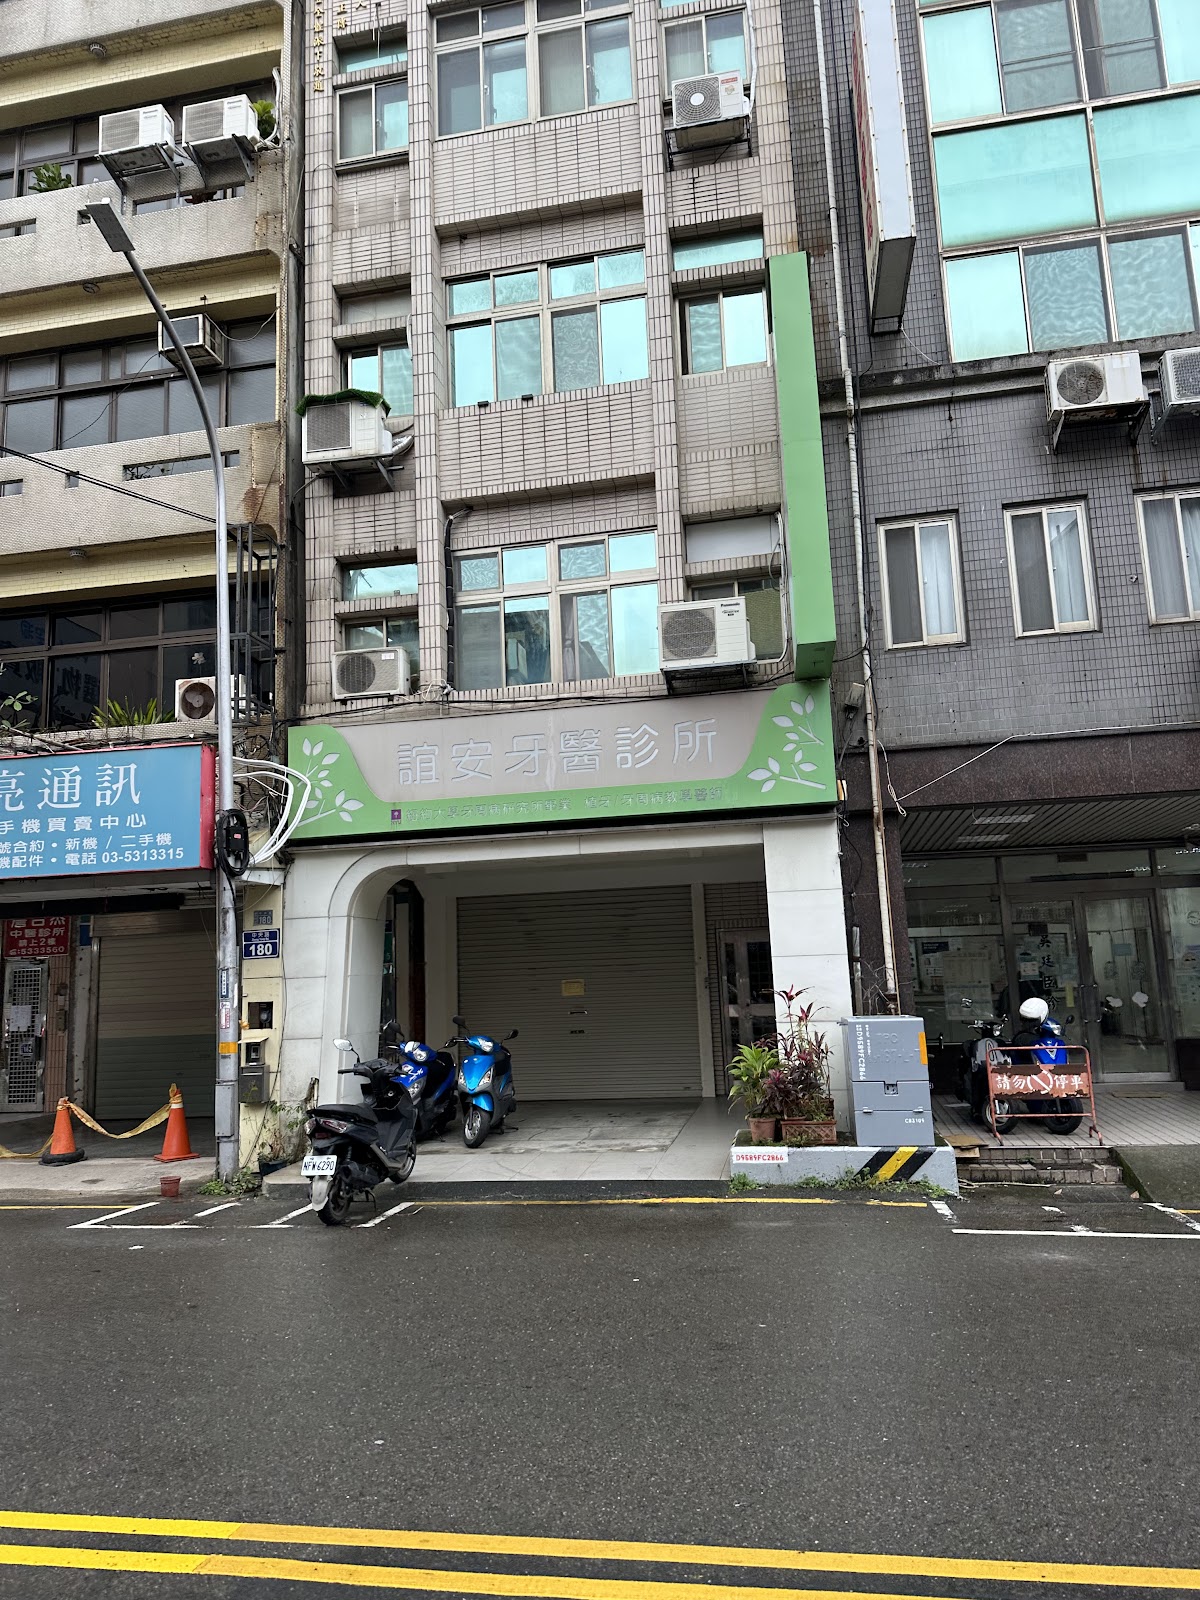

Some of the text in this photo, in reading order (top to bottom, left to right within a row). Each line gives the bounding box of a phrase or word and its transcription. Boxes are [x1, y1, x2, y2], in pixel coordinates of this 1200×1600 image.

[397, 717, 718, 786] 誼安牙醫診所
[0, 762, 141, 812] 亮通訊
[0, 813, 146, 835] 手機買賣中心
[102, 847, 184, 864] 03-5313315
[259, 916, 272, 924] 180
[10, 927, 65, 938] 中醫診所
[249, 943, 273, 956] 180
[995, 1075, 1026, 1090] 請勿
